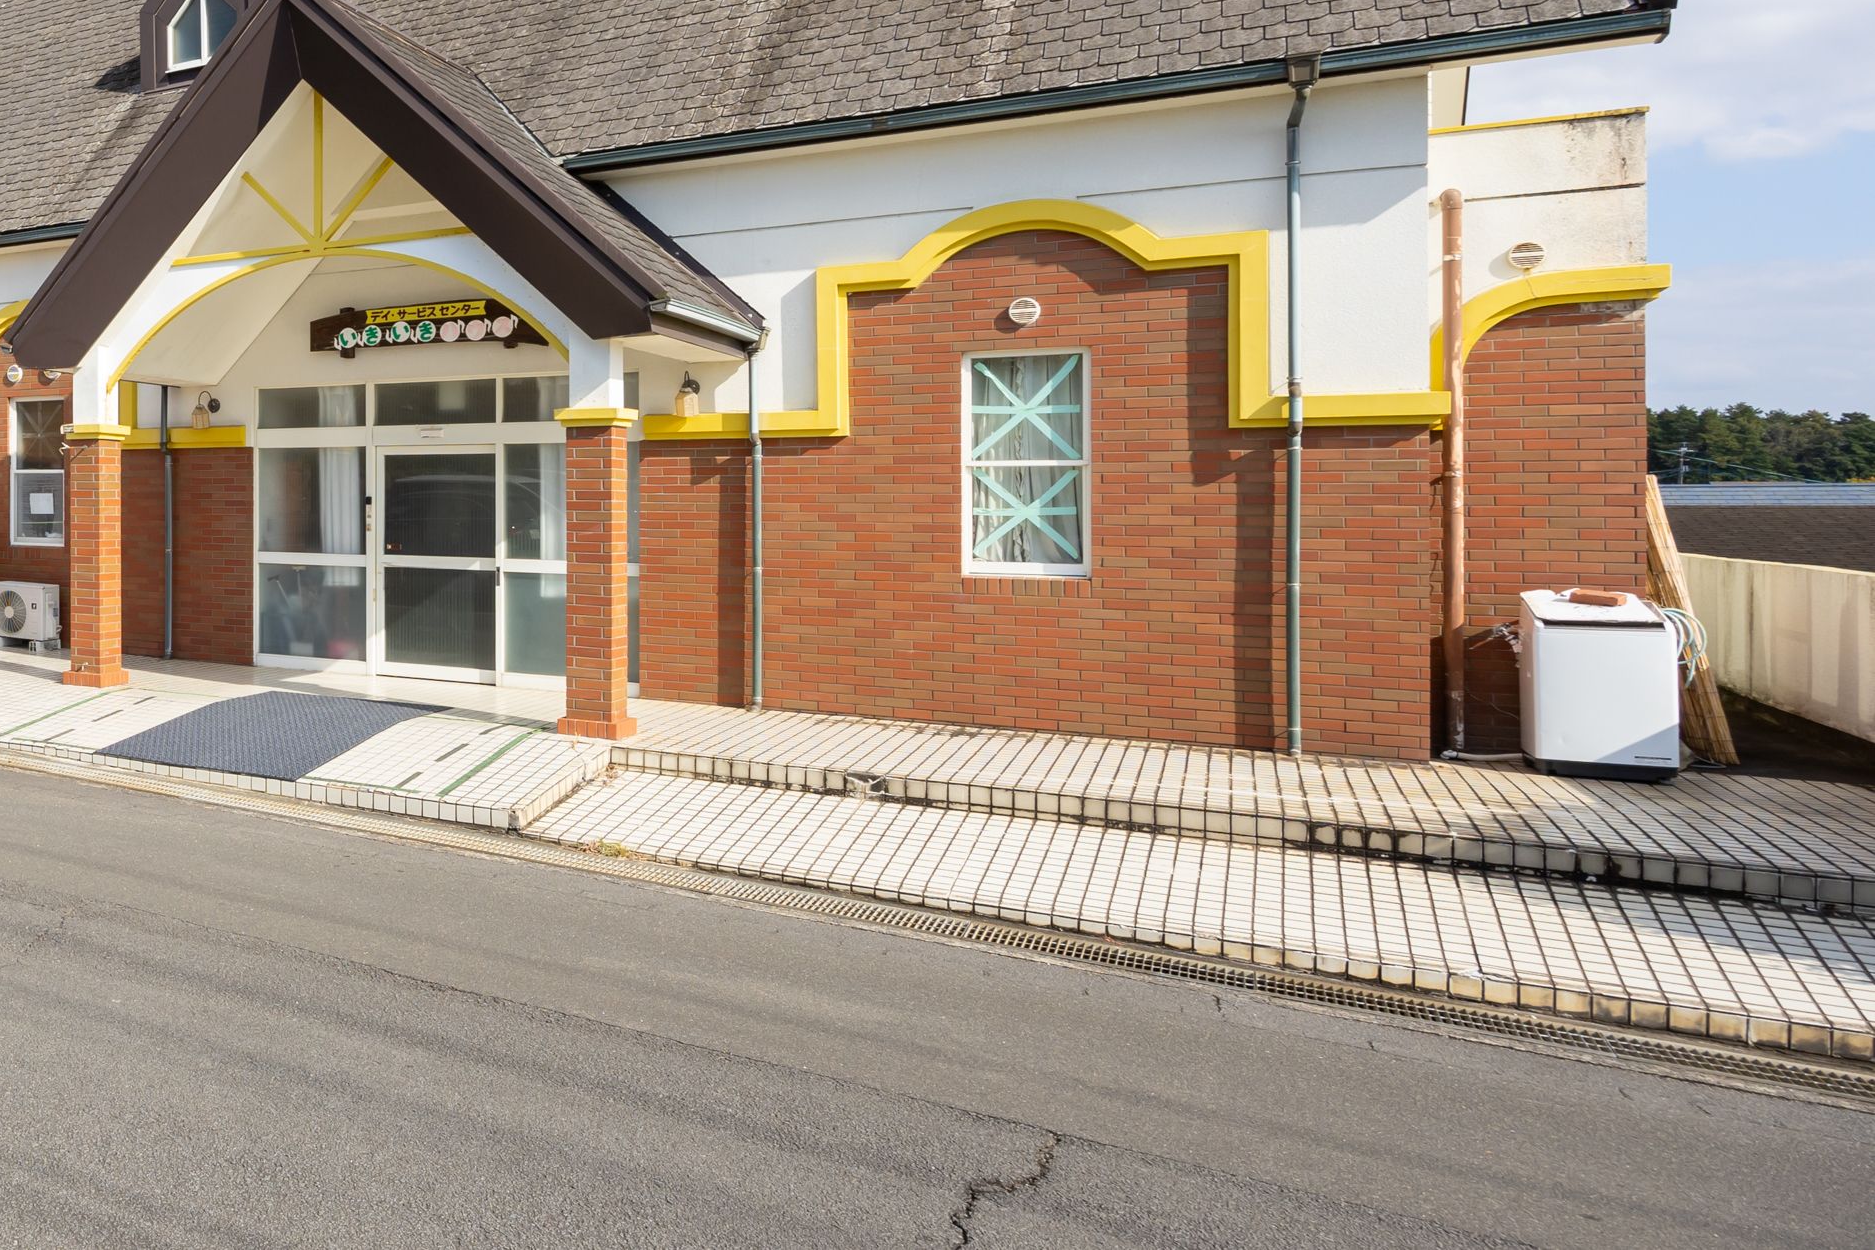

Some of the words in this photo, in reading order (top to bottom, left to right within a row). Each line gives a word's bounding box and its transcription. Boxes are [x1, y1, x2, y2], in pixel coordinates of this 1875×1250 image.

[338, 317, 513, 348] いきいきハウス
